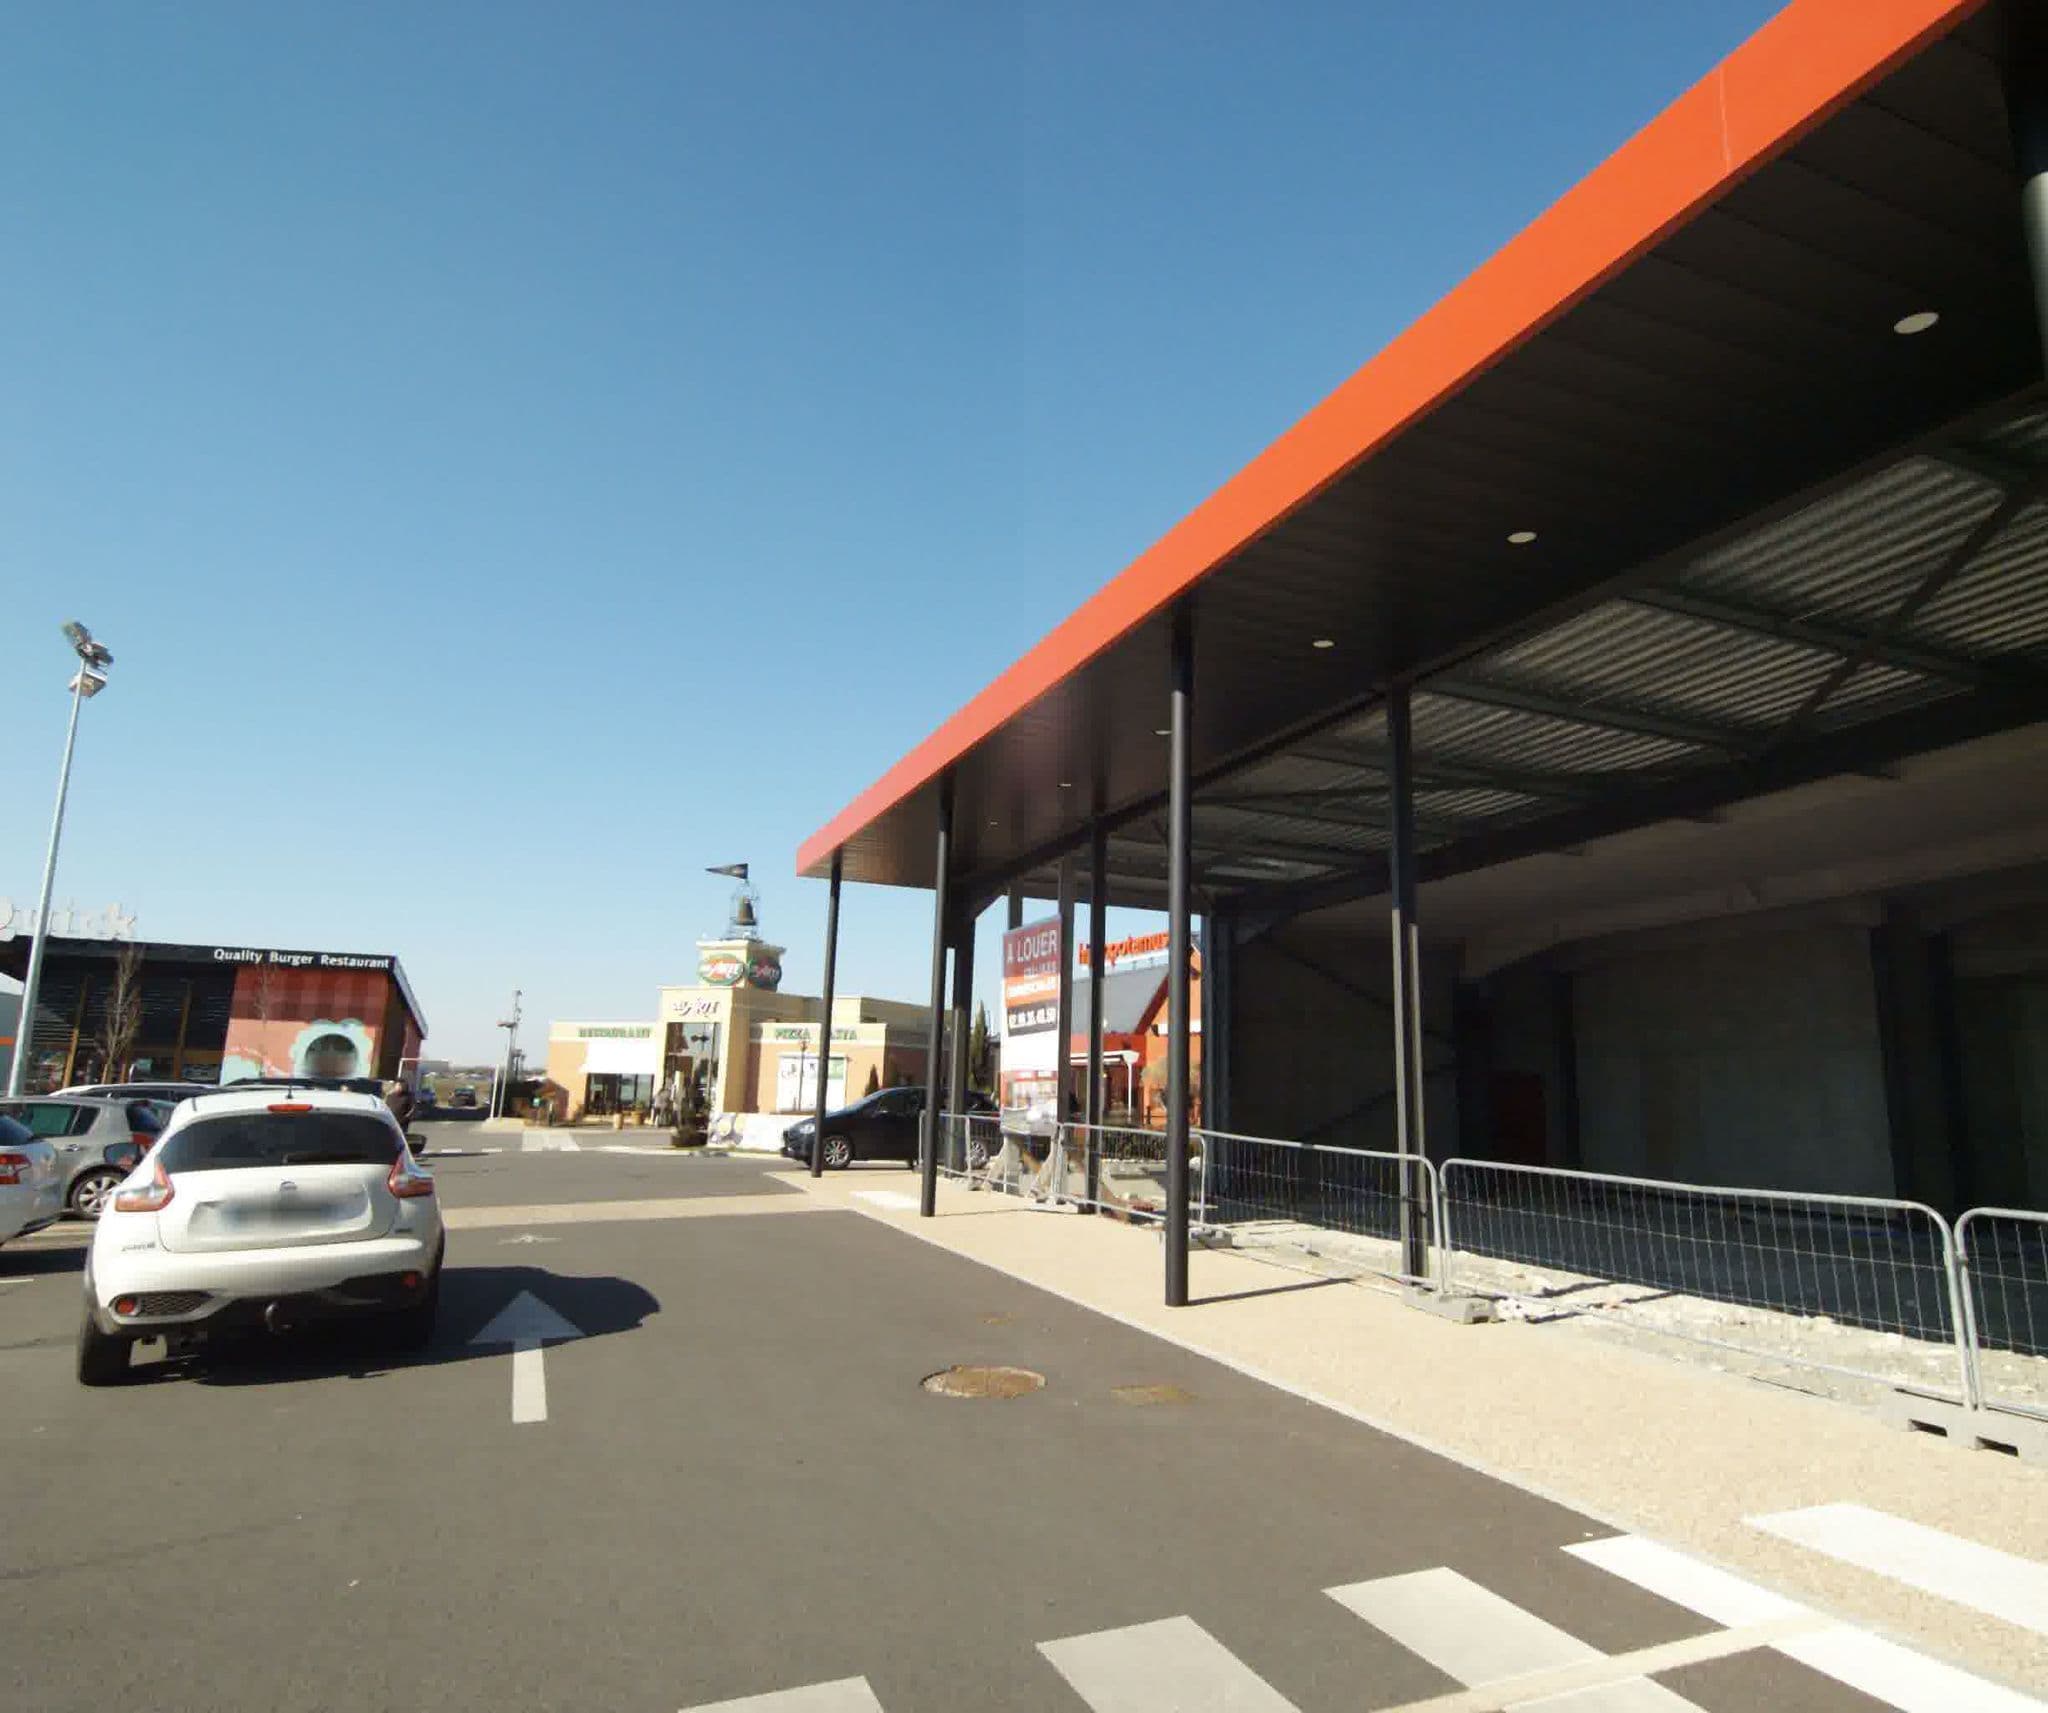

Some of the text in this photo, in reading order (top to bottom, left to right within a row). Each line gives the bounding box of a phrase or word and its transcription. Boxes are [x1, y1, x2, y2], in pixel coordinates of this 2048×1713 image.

[213, 948, 389, 969] Quality Burger Restaurant
[1016, 929, 1058, 963] LOUER
